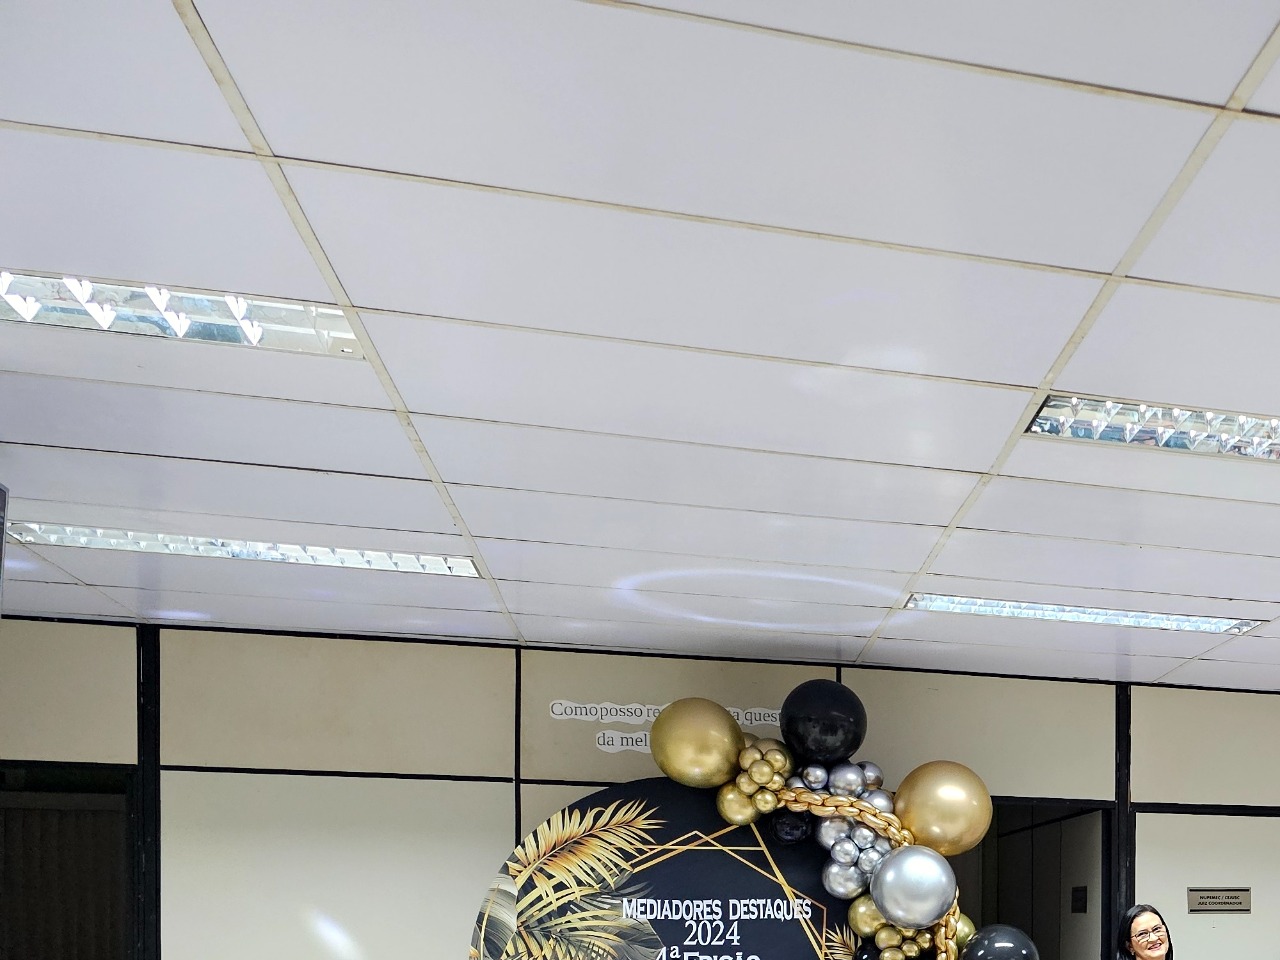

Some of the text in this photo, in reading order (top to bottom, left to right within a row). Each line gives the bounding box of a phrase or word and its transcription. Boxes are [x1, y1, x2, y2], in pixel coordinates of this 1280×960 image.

[551, 702, 598, 716] Como
[600, 706, 643, 720] posso
[597, 733, 648, 747] da mel
[622, 898, 812, 922] MEDIADORES DESTAQUES
[683, 920, 740, 946] 2024
